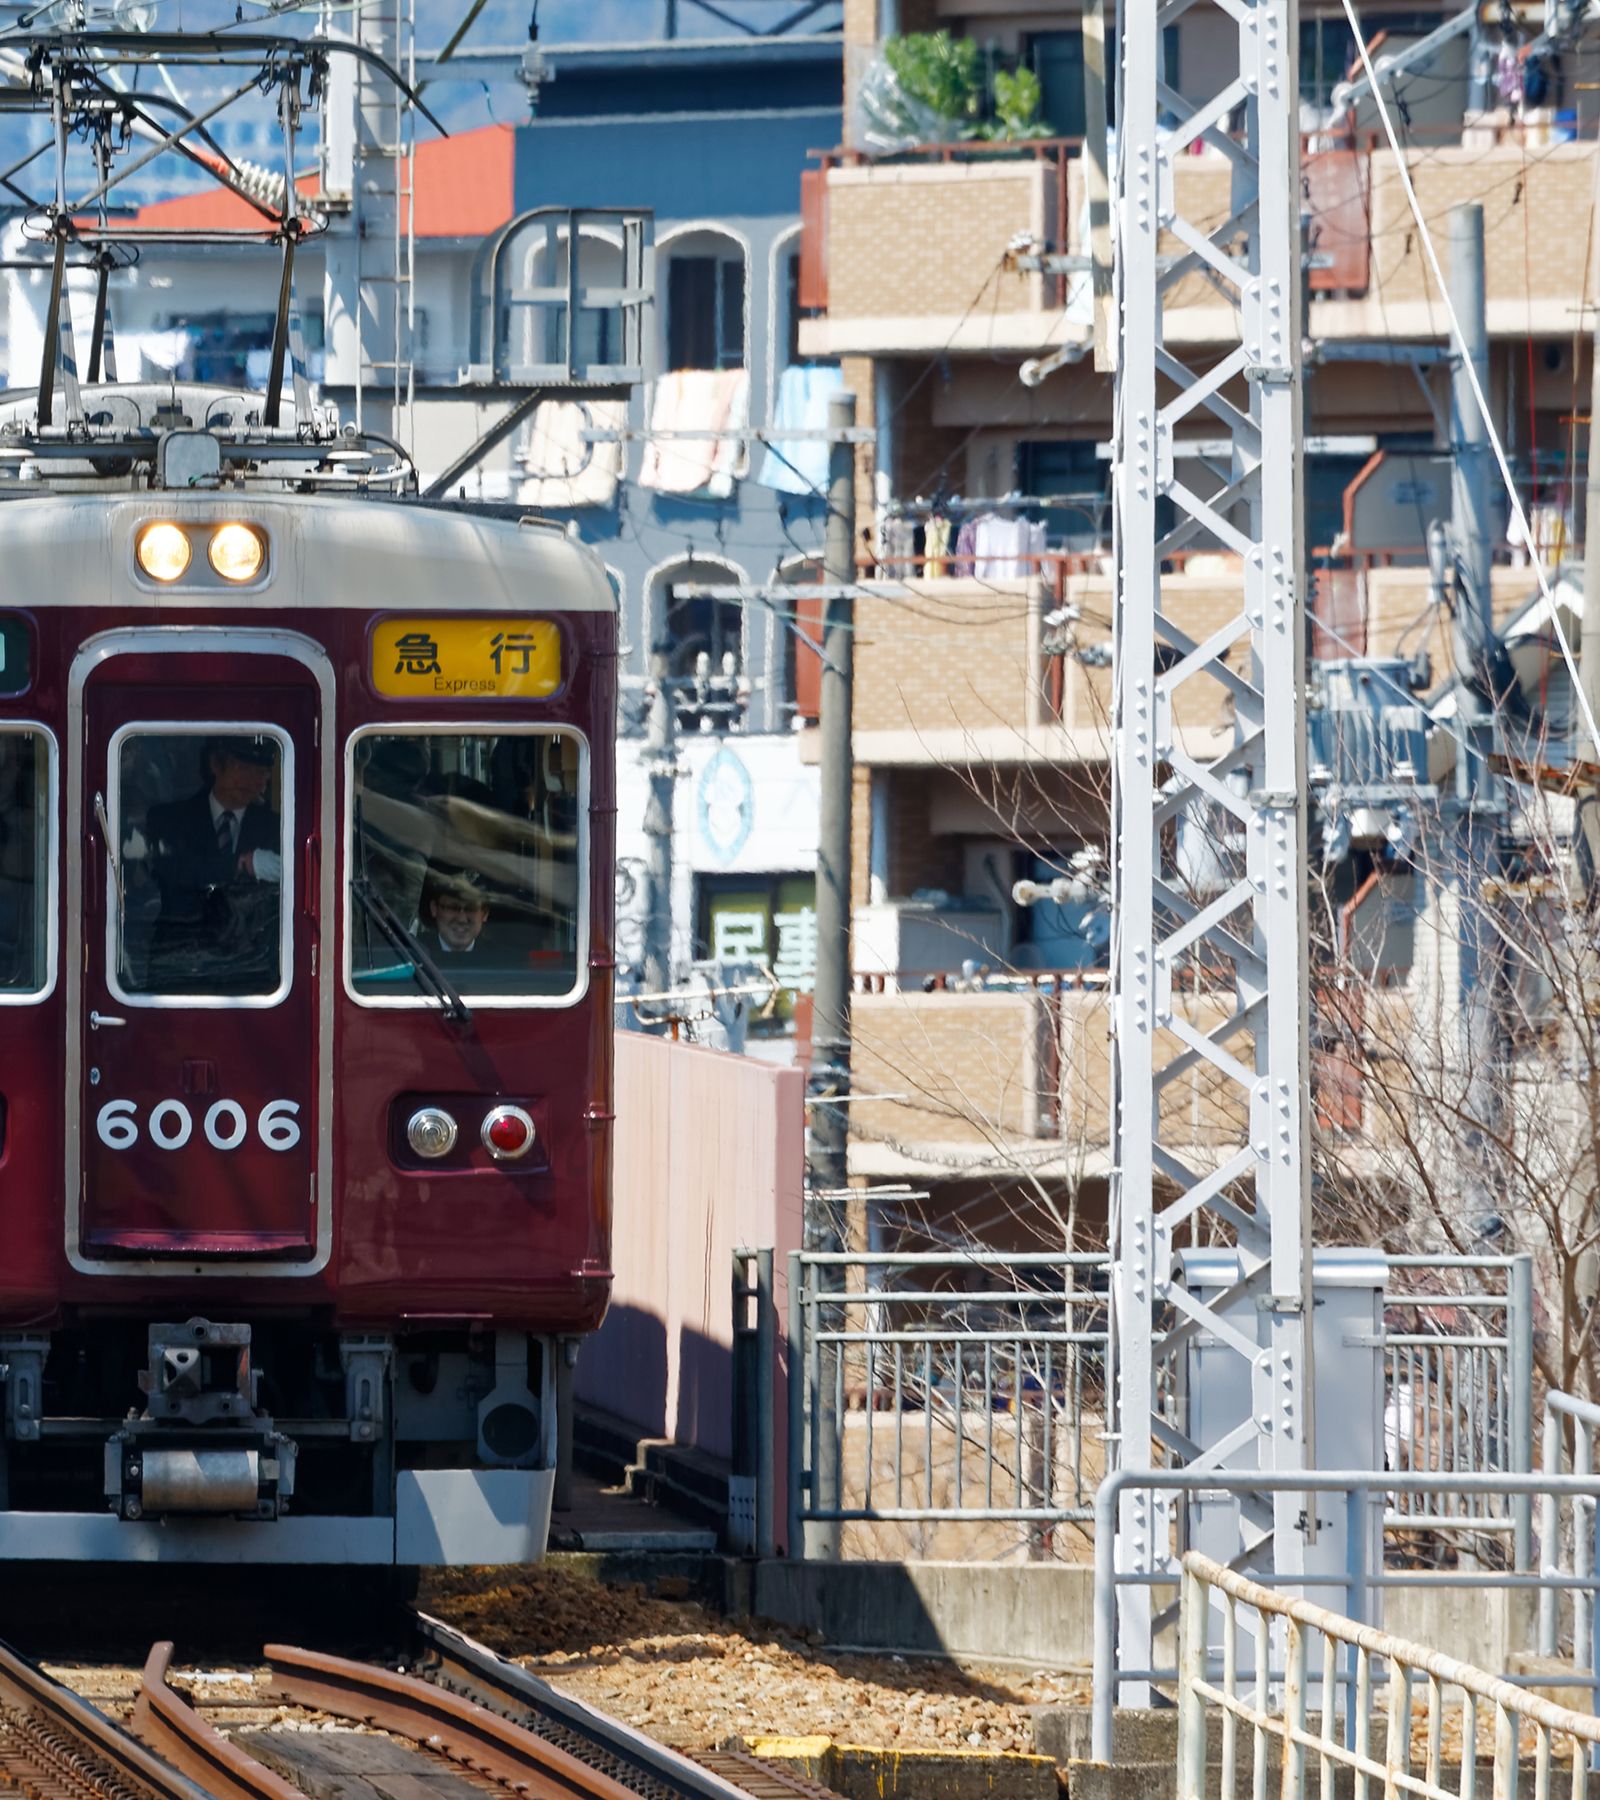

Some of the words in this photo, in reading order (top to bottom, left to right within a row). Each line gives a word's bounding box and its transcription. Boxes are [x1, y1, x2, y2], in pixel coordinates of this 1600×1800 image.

[394, 632, 537, 675] 急行
[434, 676, 496, 693] Express
[96, 1098, 301, 1151] 6006
